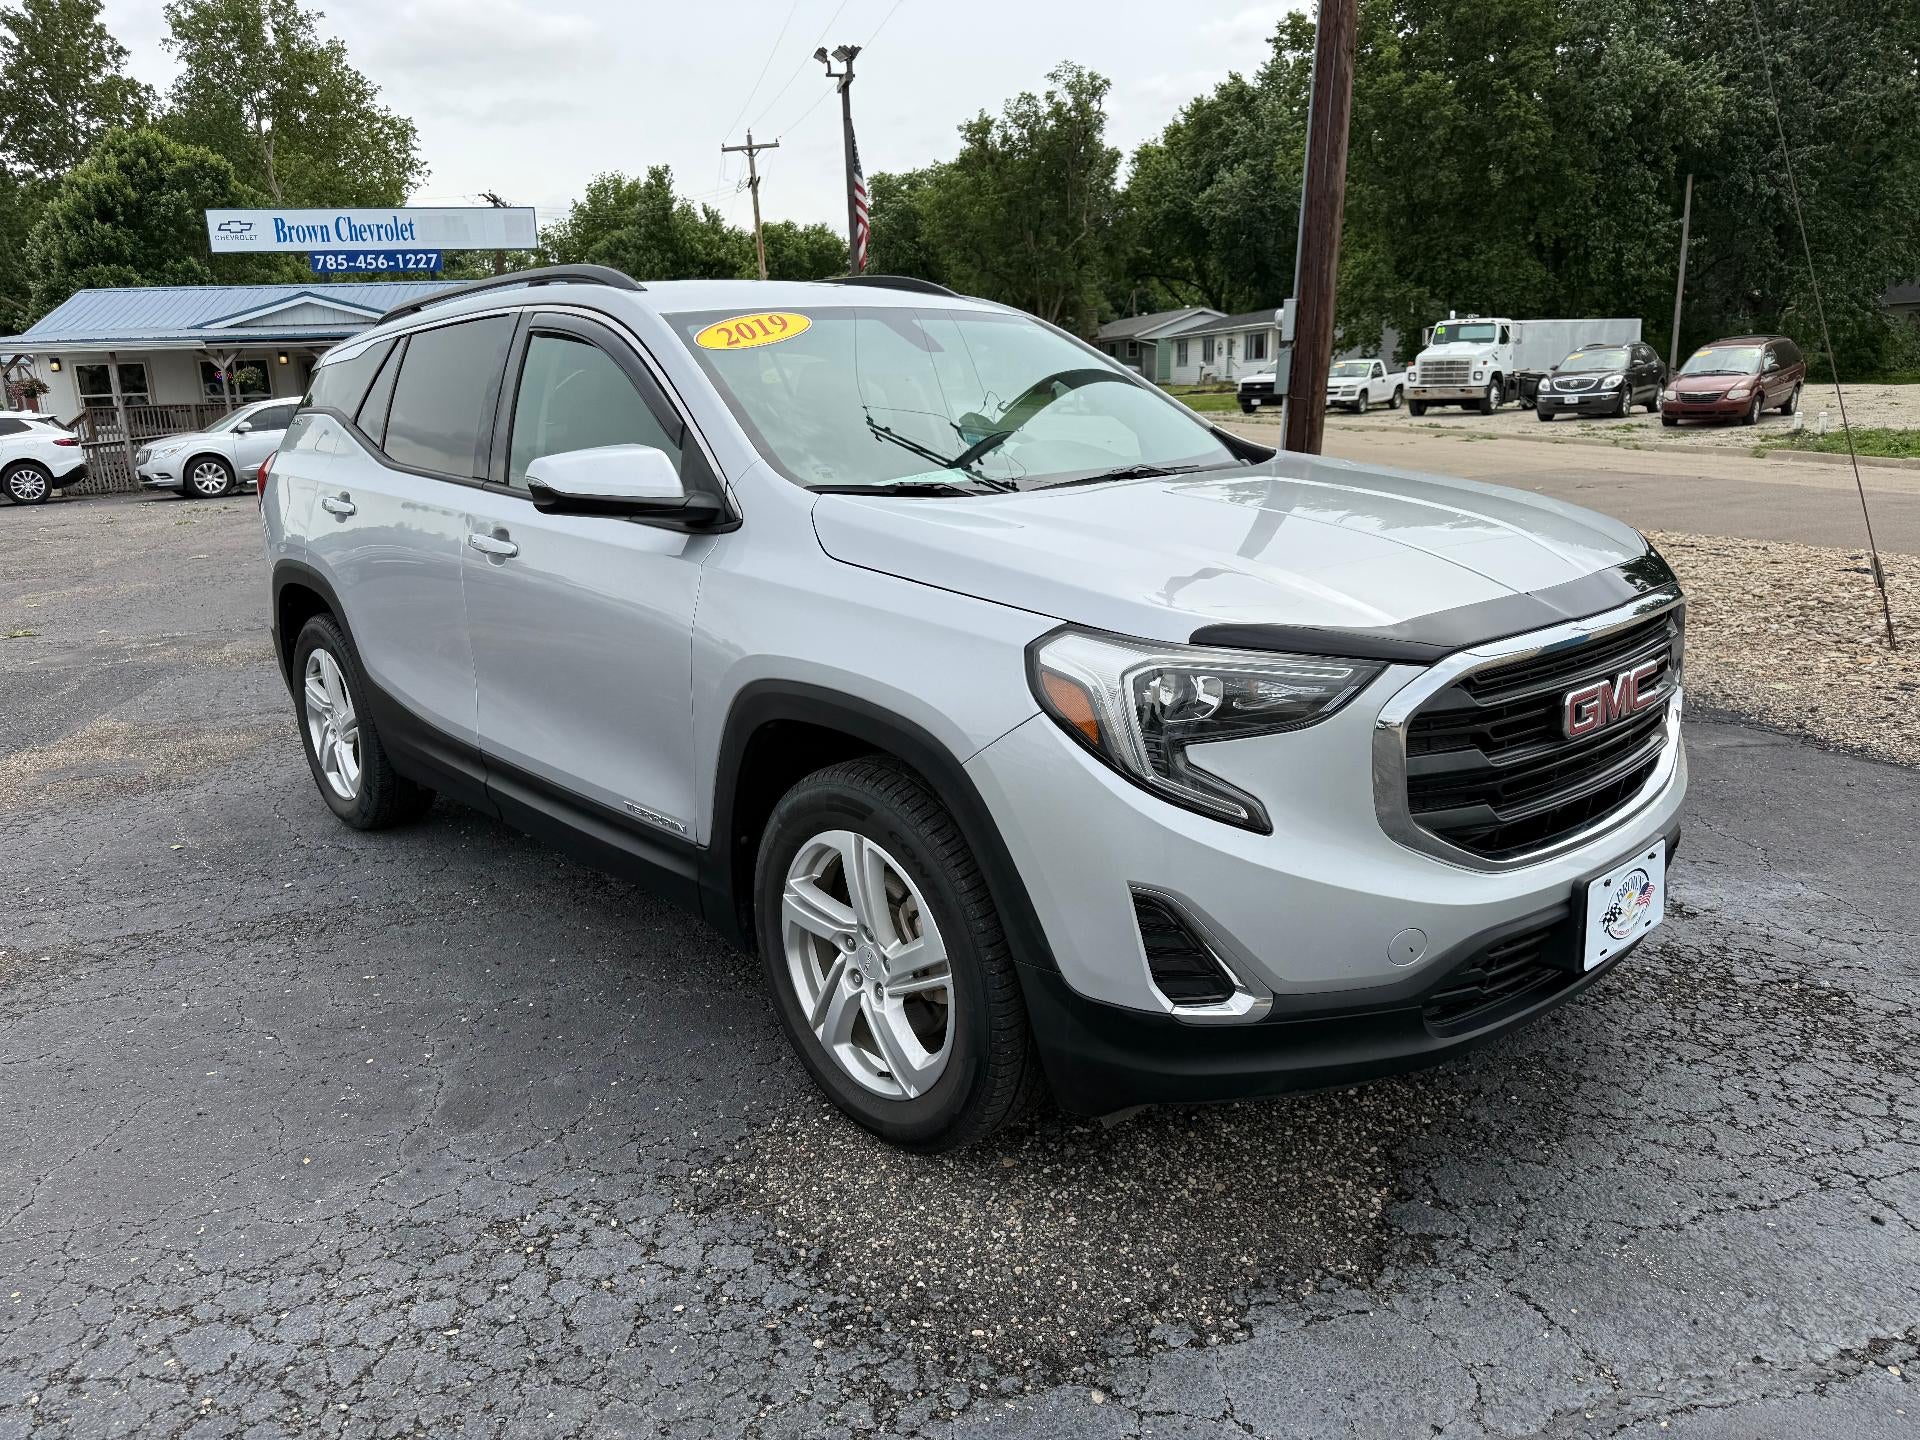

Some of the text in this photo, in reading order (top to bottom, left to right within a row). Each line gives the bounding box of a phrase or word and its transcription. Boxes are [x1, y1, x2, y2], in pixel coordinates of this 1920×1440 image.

[272, 215, 416, 243] Brown Chevrolet
[313, 253, 438, 270] 785-456-1227
[717, 314, 788, 346] 2019
[1562, 658, 1657, 738] GMC
